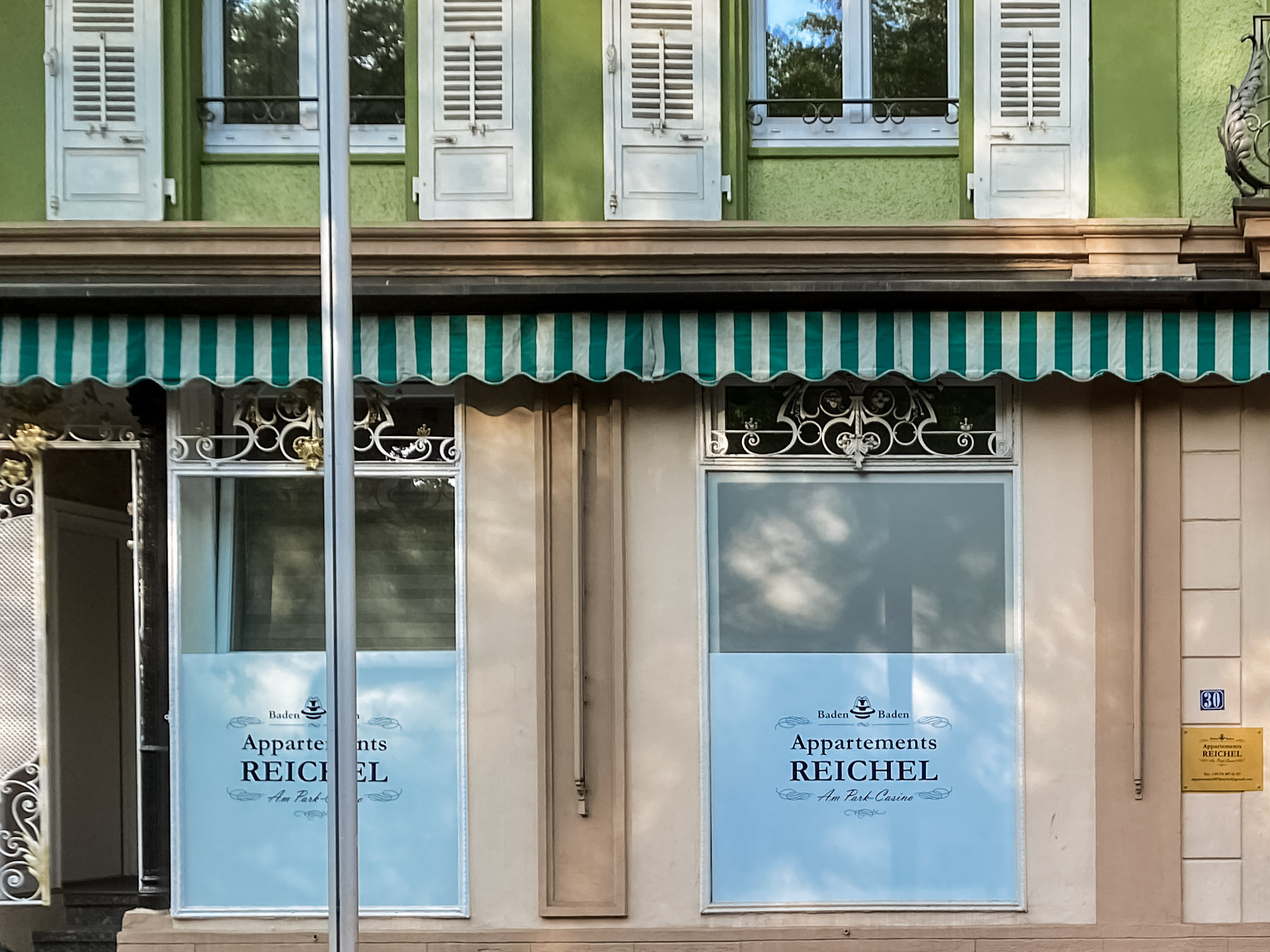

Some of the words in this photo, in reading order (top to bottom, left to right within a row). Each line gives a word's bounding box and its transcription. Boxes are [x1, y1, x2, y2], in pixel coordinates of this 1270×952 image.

[1203, 691, 1221, 709] 30
[269, 710, 300, 719] Baden
[817, 710, 849, 719] Baden
[878, 710, 909, 719] Baden
[241, 734, 387, 756] Appartents
[790, 733, 937, 756] Appartements
[240, 761, 388, 782] REICEL
[790, 760, 938, 782] REICHEL
[268, 789, 290, 803] Am
[817, 788, 841, 802] Am
[844, 788, 914, 802] Park-Casino
